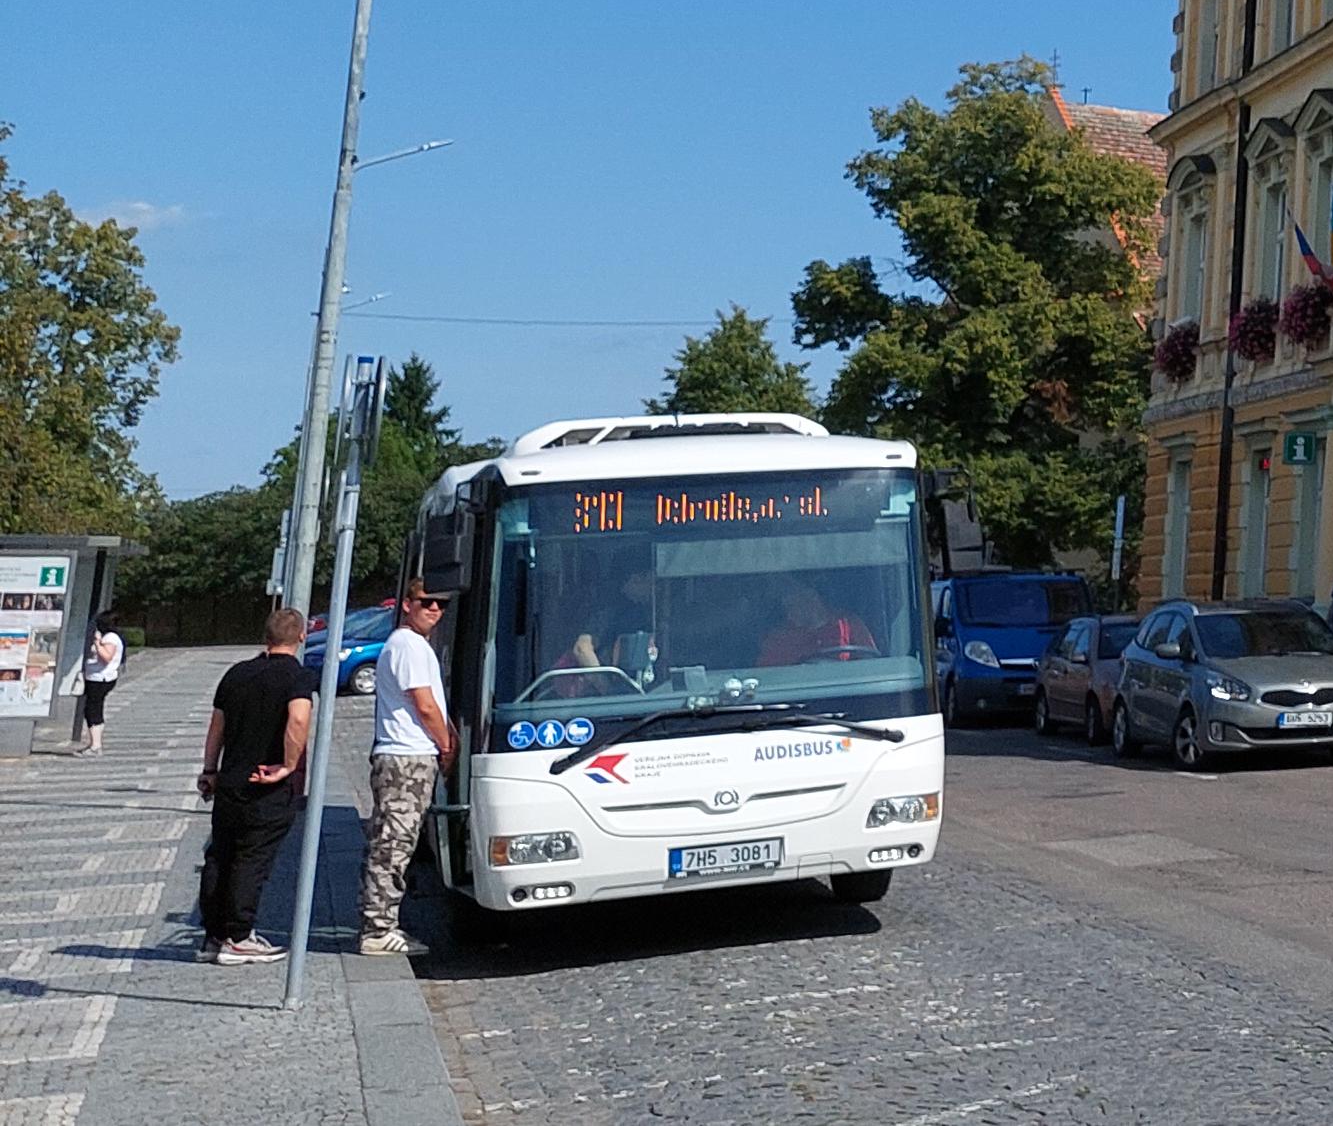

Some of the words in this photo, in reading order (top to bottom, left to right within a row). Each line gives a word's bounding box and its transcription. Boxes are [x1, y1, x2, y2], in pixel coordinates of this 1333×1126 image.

[754, 740, 833, 762] AUDISBUS
[686, 849, 717, 868] 7H5
[730, 844, 771, 863] 3081
